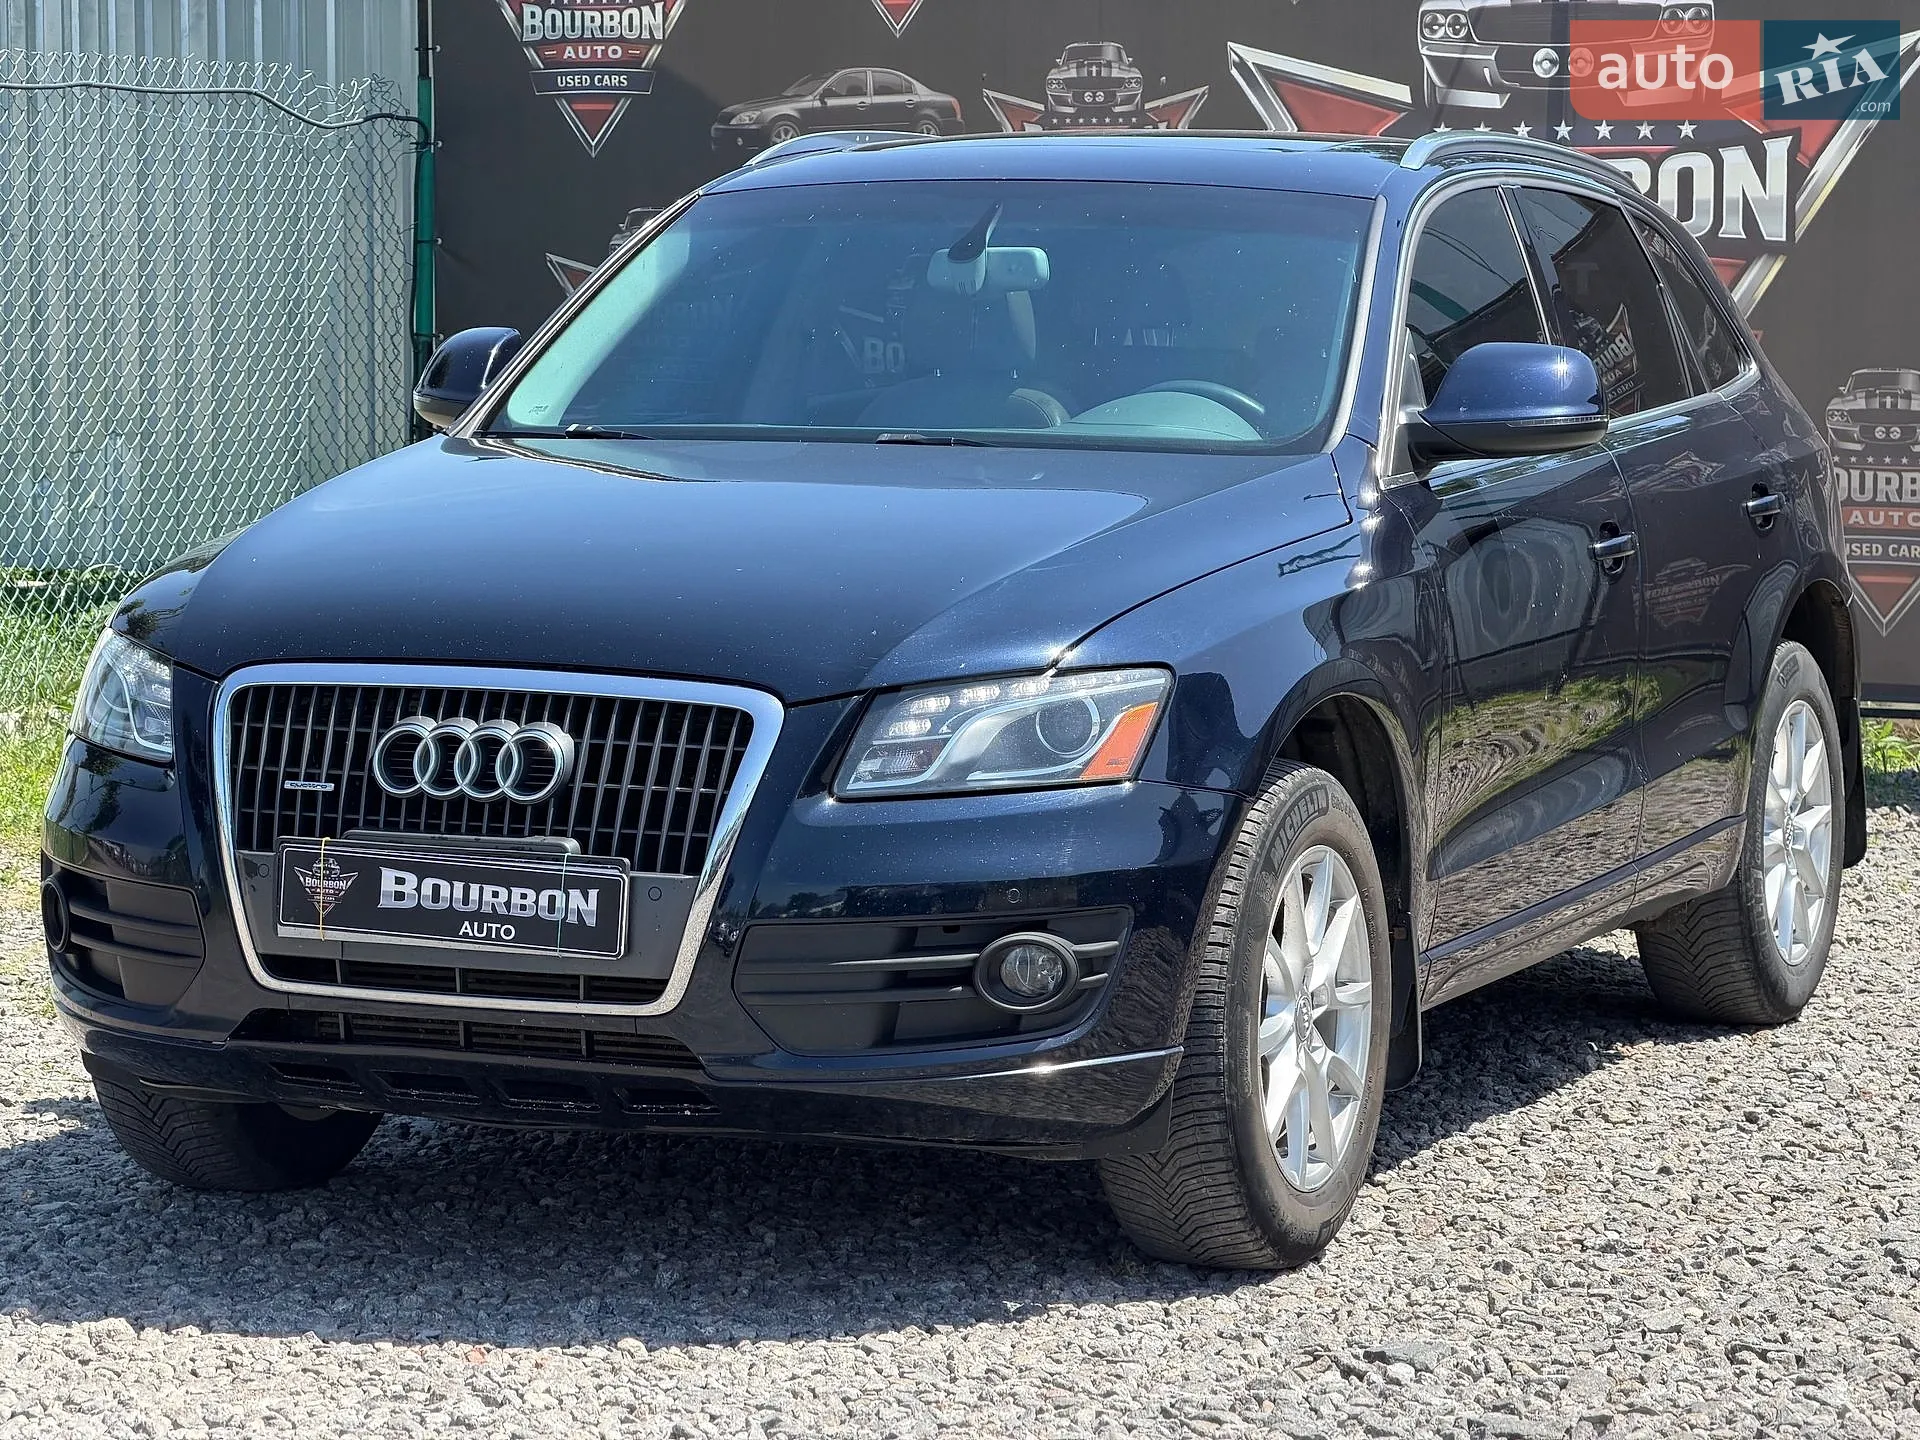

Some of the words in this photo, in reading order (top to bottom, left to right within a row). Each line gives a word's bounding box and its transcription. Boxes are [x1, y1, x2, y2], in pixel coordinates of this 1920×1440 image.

[522, 2, 664, 42] BOURBON
[563, 46, 622, 60] AUTO
[557, 75, 591, 88] USED
[594, 75, 628, 87] CARS
[1269, 787, 1329, 874] MICHELIN
[377, 866, 600, 927] BOURBON
[458, 920, 516, 940] AUTO
